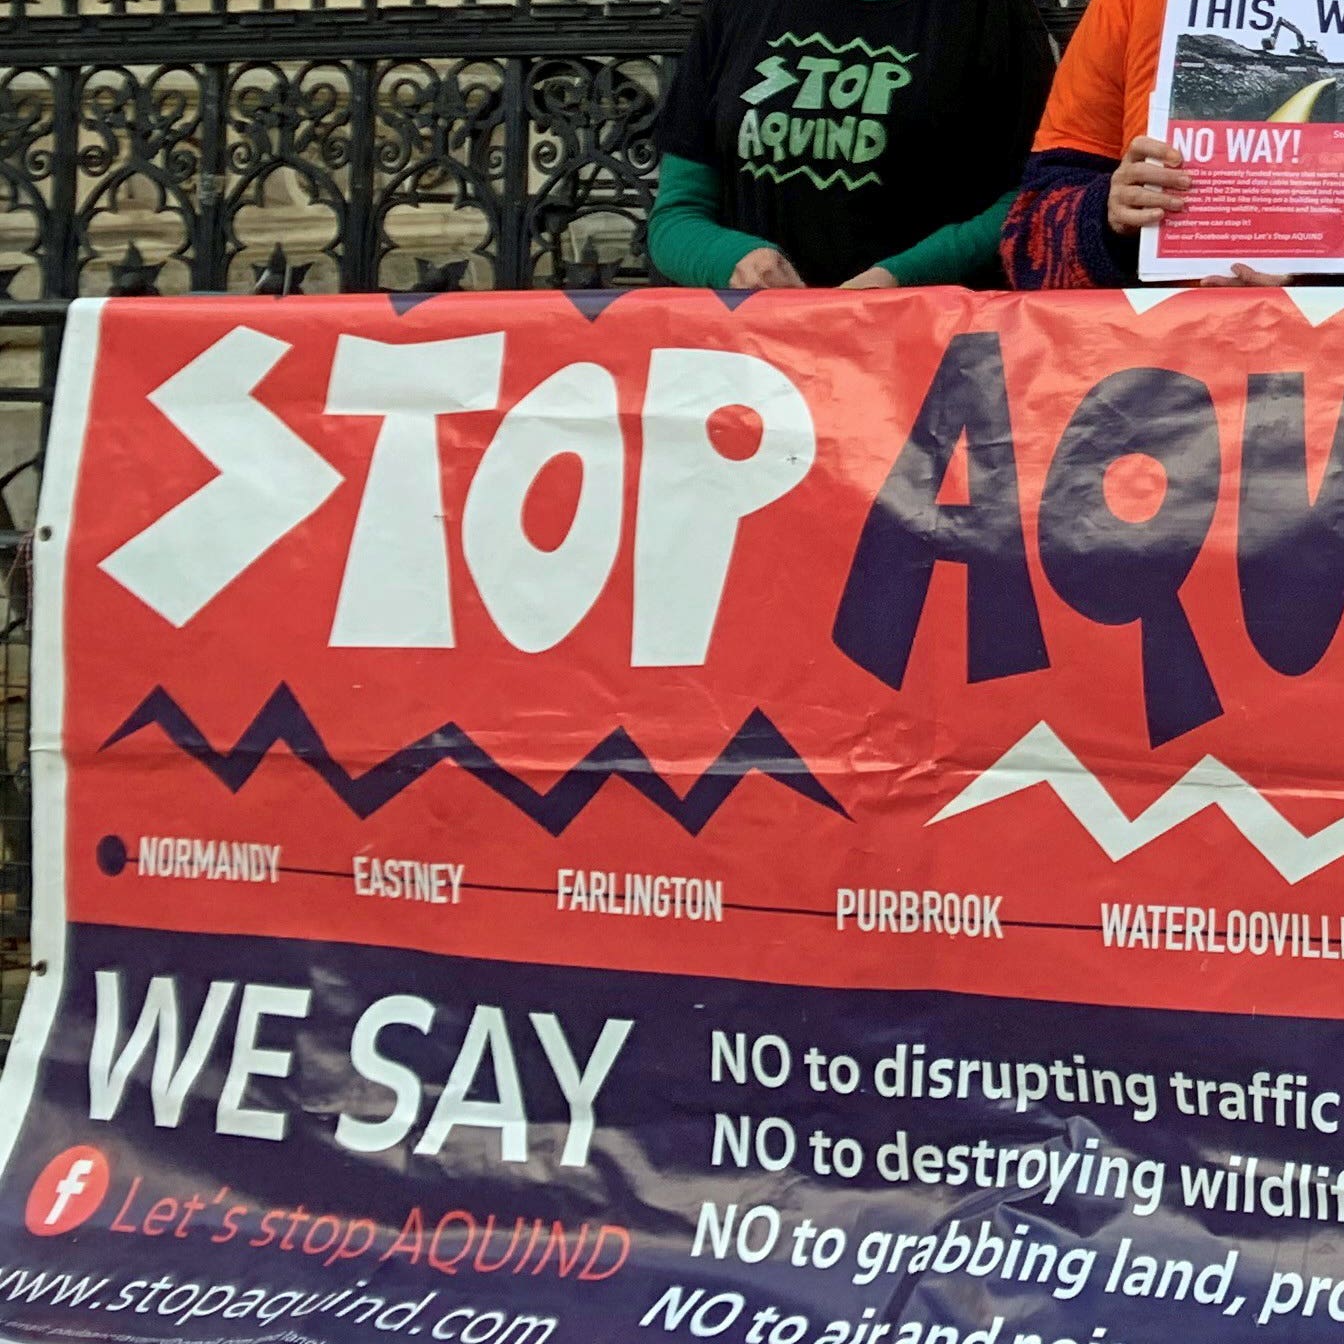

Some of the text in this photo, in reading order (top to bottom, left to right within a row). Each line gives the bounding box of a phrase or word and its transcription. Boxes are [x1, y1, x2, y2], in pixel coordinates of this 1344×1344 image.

[738, 109, 887, 163] AQUIND
[740, 56, 912, 114] STOP
[1173, 127, 1301, 163] NO WAY!
[97, 325, 814, 667] STOP
[137, 836, 281, 883] NORMANDY
[354, 856, 464, 905] EASTNEY
[557, 869, 724, 923] FARLINGTON
[836, 888, 1003, 940] PURBROOK
[89, 971, 635, 1168] WE SAY
[711, 1030, 790, 1088] NO
[804, 1047, 860, 1094] to
[874, 1044, 1158, 1122] disrupting
[1169, 1071, 1341, 1134] traffic
[711, 1113, 796, 1171] NO
[809, 1130, 863, 1177] to
[876, 1131, 1165, 1216] destroying
[110, 1177, 249, 1246] Let's
[249, 1206, 375, 1266] stop
[379, 1207, 631, 1281] AQUIND
[690, 1201, 781, 1264] NO
[790, 1219, 846, 1269] to
[852, 1219, 1097, 1299] grabbing
[1105, 1238, 1247, 1316] land,
[639, 1286, 746, 1338] NO
[745, 1309, 807, 1344] to
